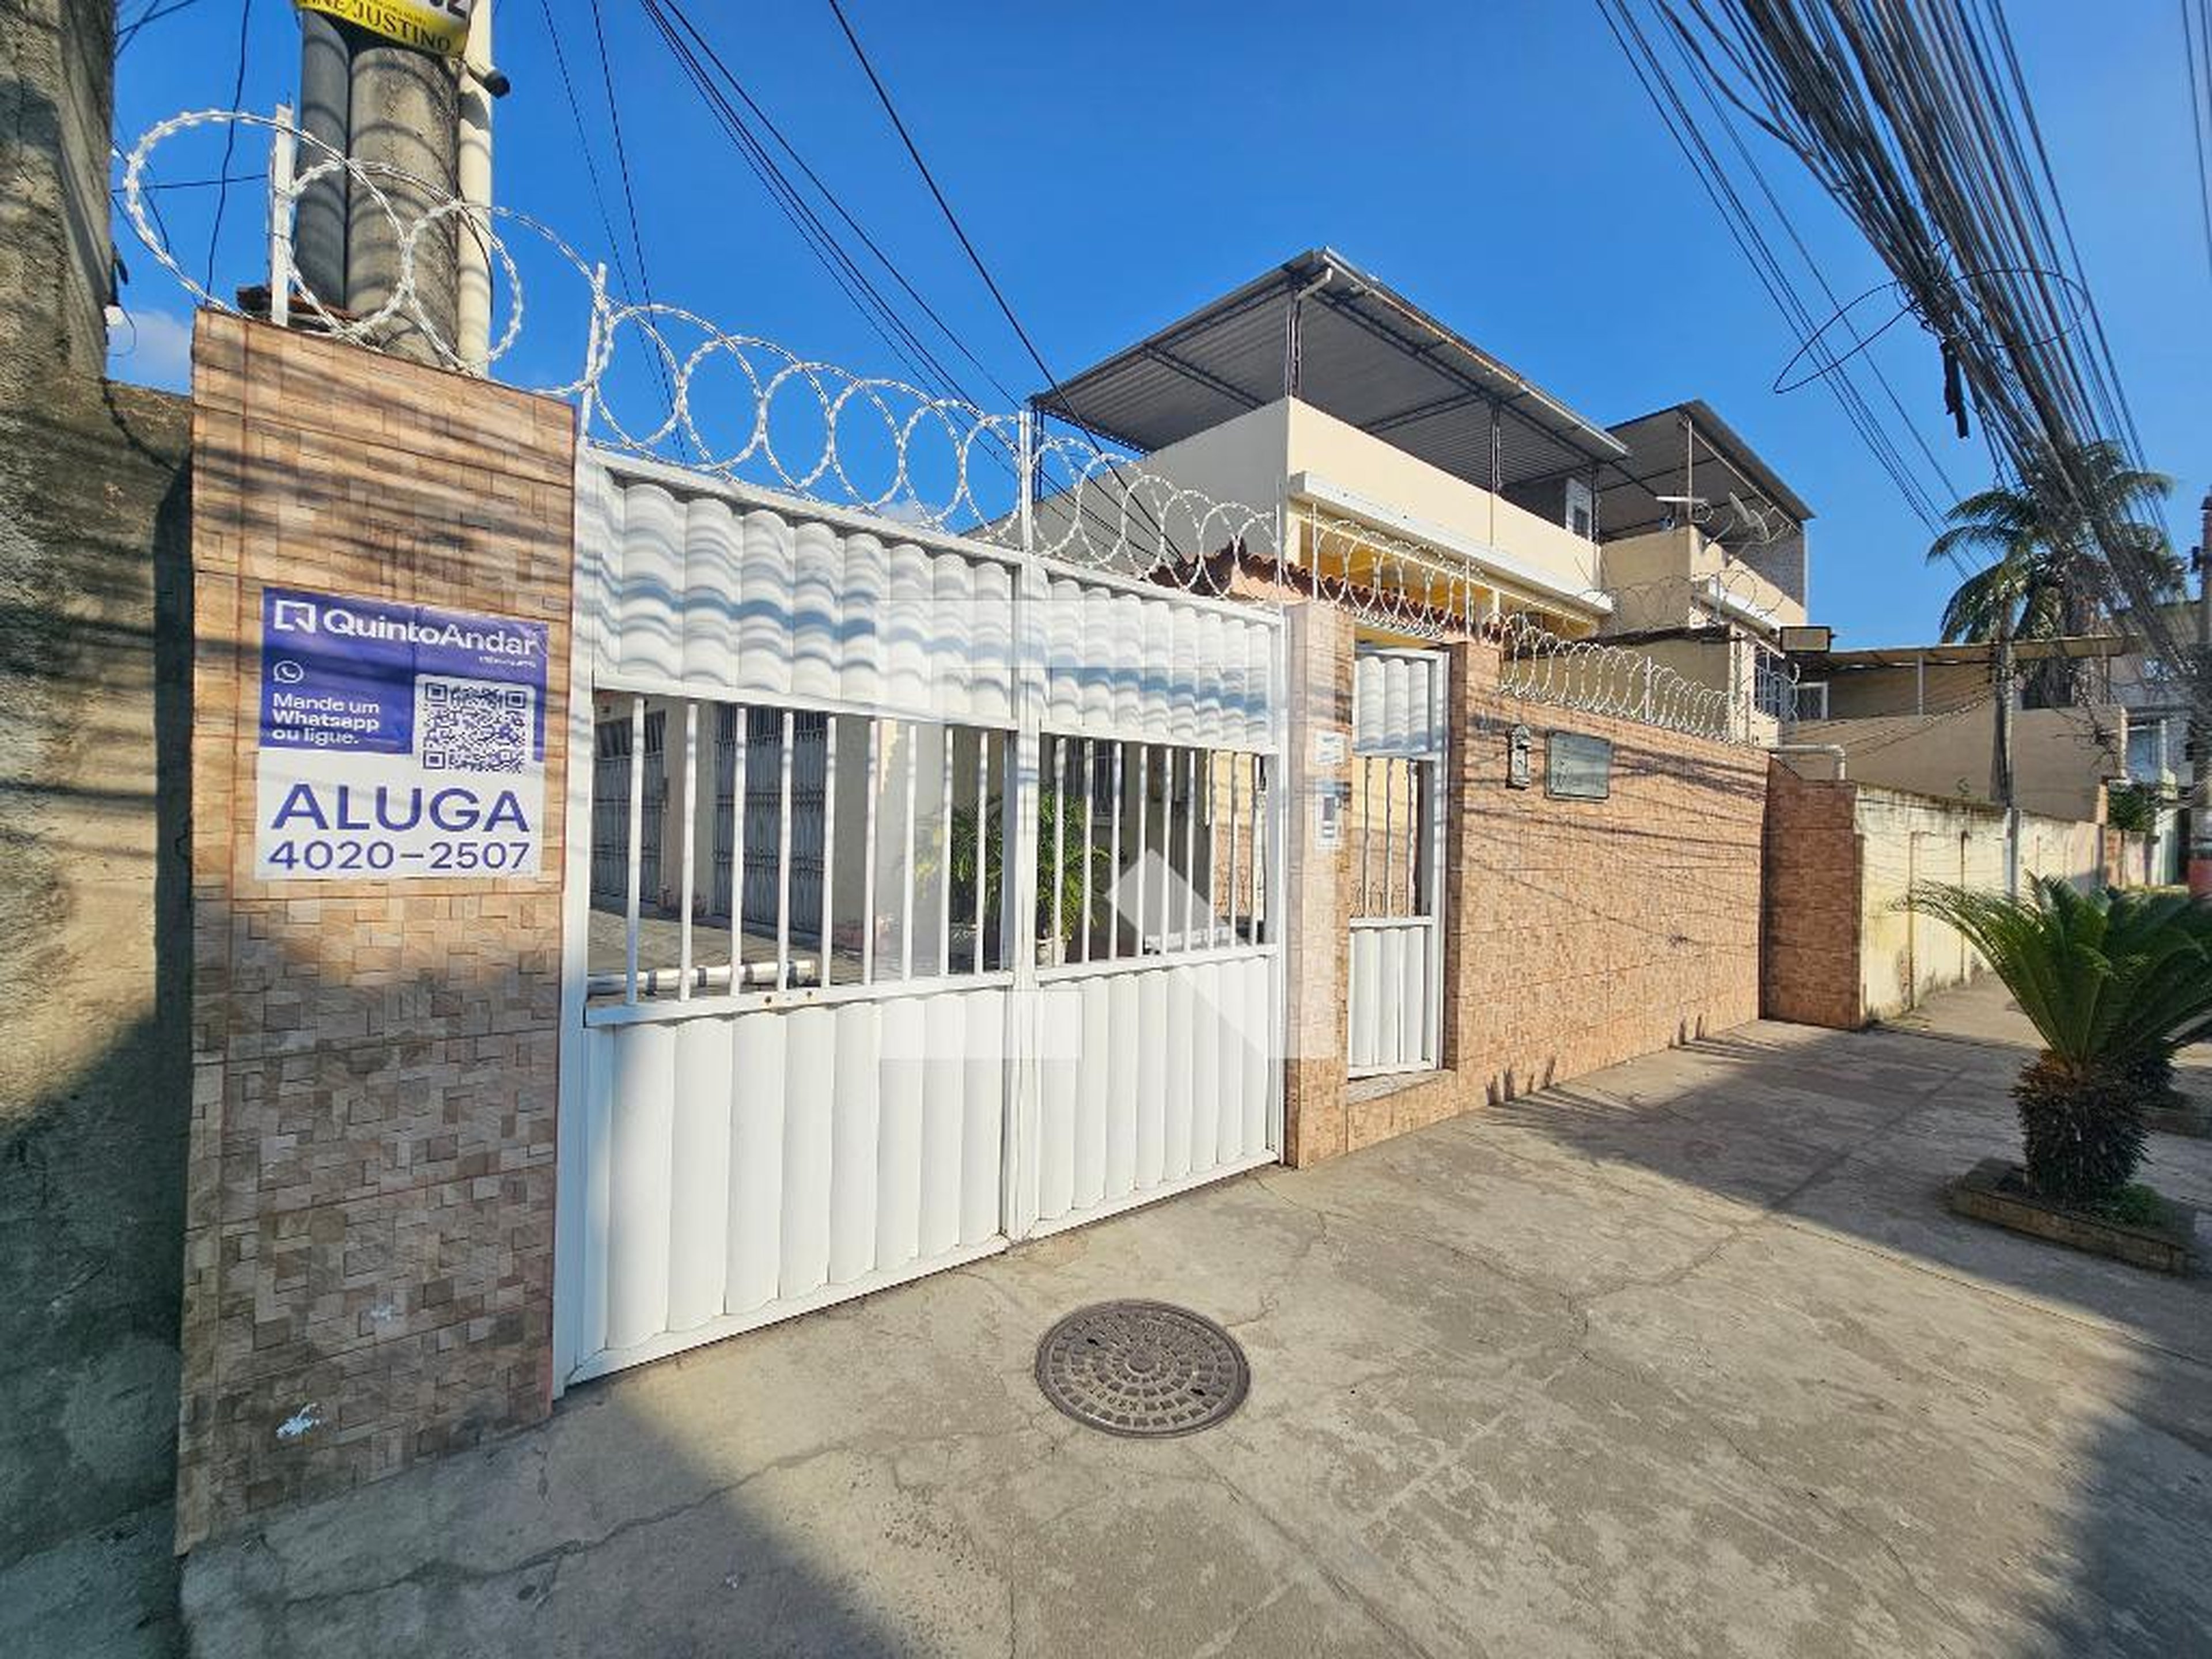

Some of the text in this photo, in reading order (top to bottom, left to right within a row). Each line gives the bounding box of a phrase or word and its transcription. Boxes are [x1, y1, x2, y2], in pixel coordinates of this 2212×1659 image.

[353, 2, 452, 53] JUSTINO
[323, 608, 539, 656] QuintoAndar
[272, 693, 380, 714] Mande um
[272, 709, 380, 733] Whatsapp
[272, 727, 359, 747] ou ligue.
[271, 783, 530, 832] ALUGA
[268, 840, 531, 871] 4020-2507
